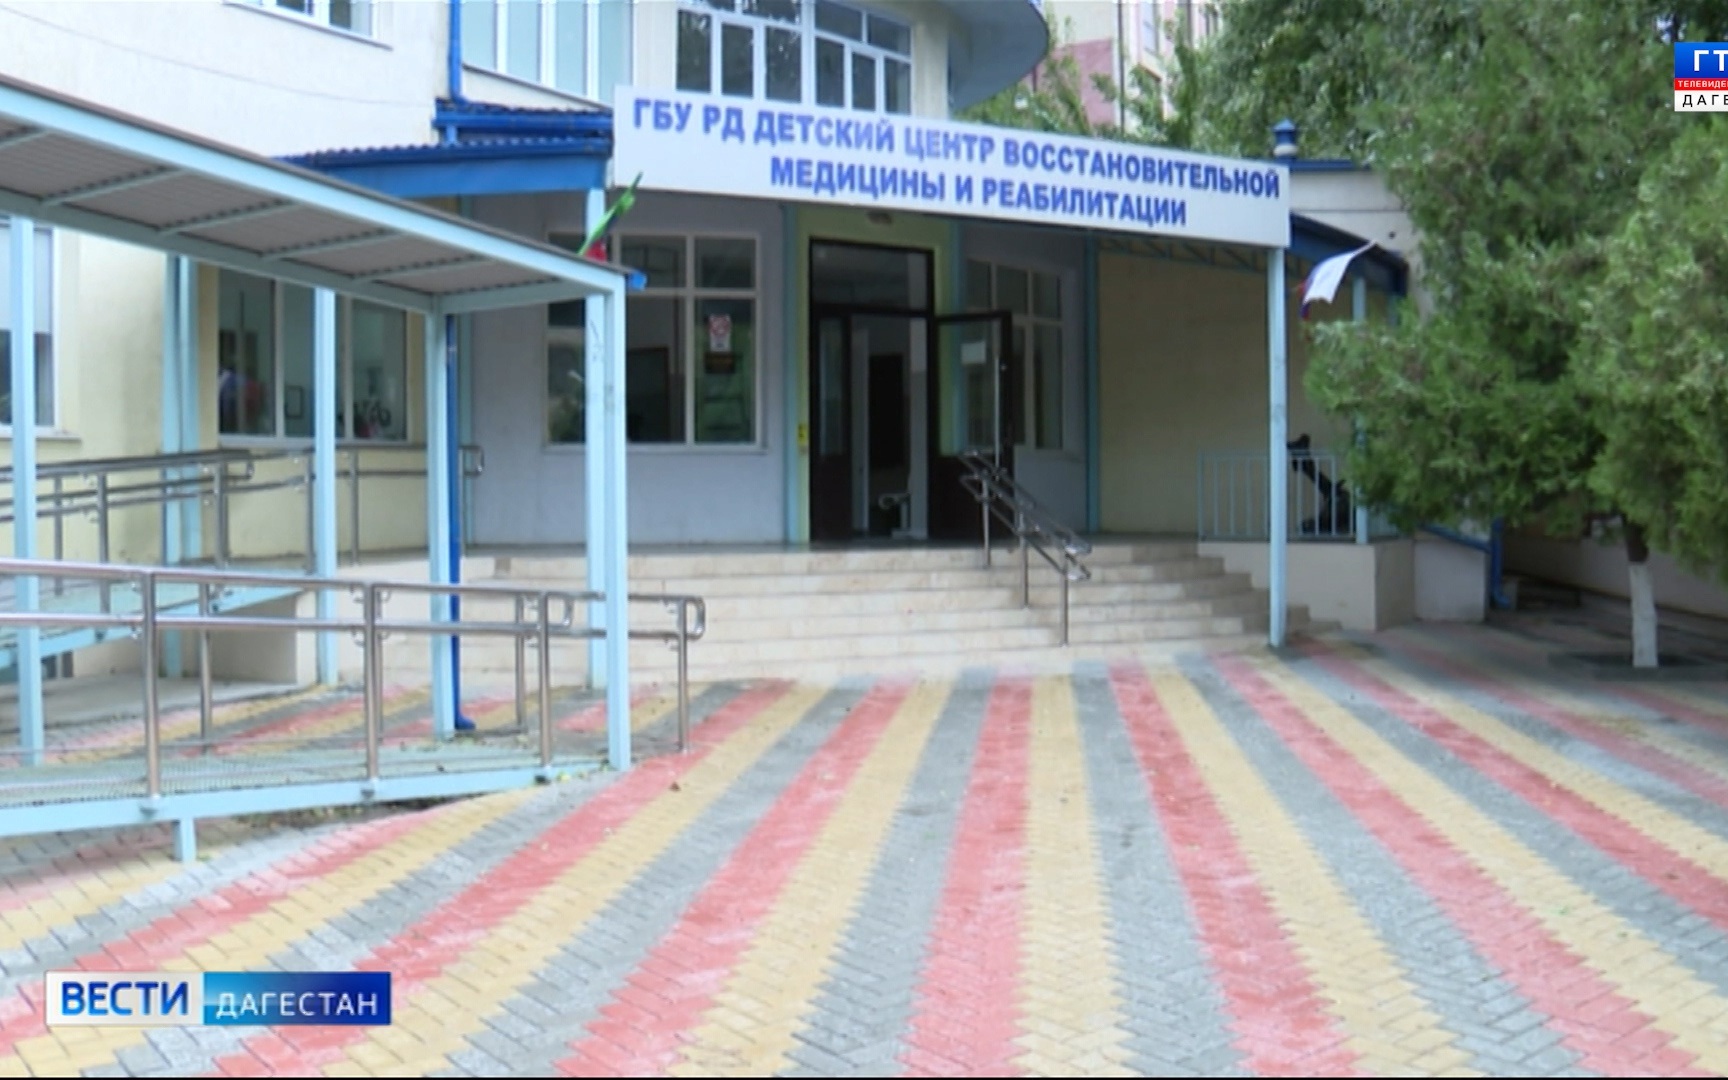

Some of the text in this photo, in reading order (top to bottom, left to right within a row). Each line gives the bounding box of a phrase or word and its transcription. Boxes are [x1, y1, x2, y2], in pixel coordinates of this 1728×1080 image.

[633, 97, 1280, 199] ГБУ РД ДЕТСКИЙ ЦЕНТР ВОССТАНОВИТЕЛЬНОЙ
[771, 156, 1187, 227] МЕДИЦИНЫ И РЕАБИЛИТАЦИИ
